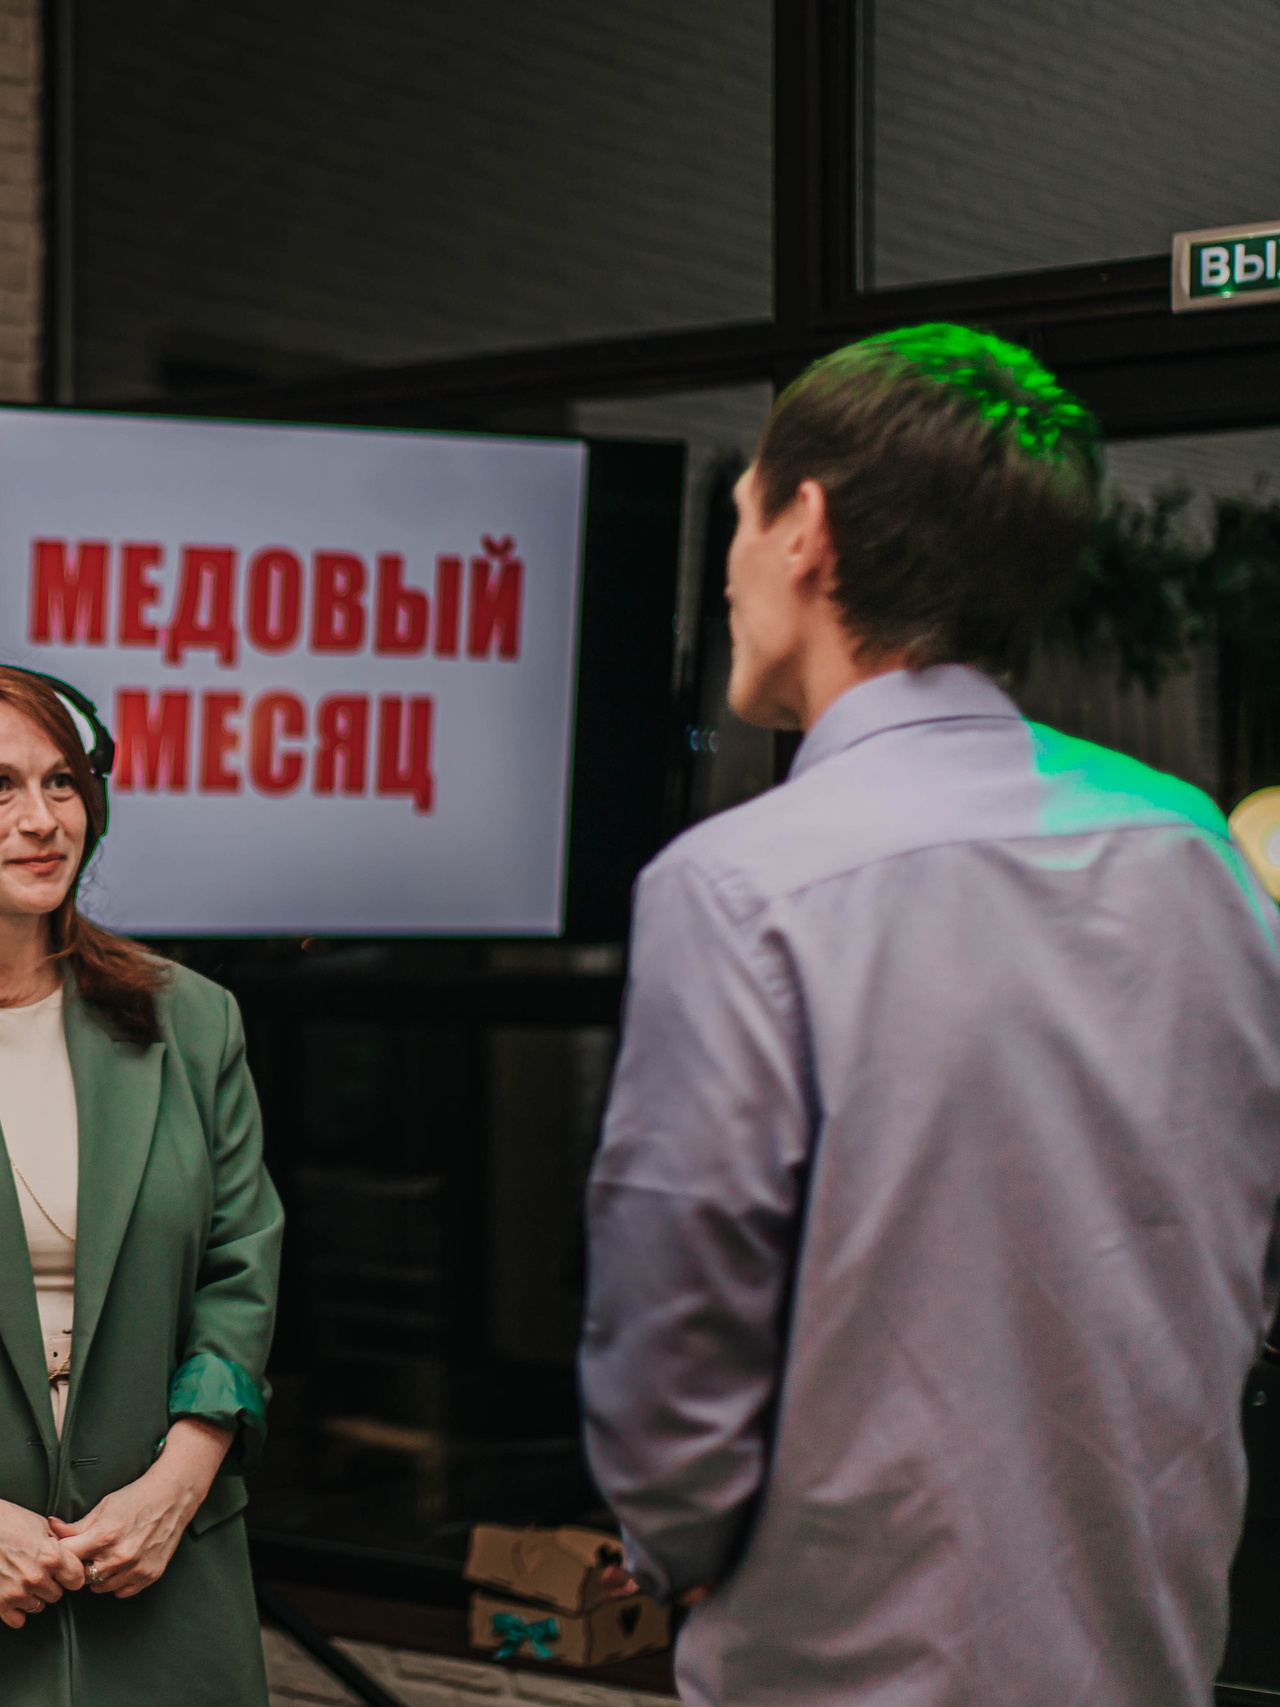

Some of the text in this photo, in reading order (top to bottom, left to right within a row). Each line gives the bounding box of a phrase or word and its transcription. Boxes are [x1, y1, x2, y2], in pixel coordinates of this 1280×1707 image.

[1200, 239, 1280, 288] ВЫ
[29, 534, 525, 667] МЕДОВЫЙ
[113, 687, 434, 815] МЕСЯЦ
